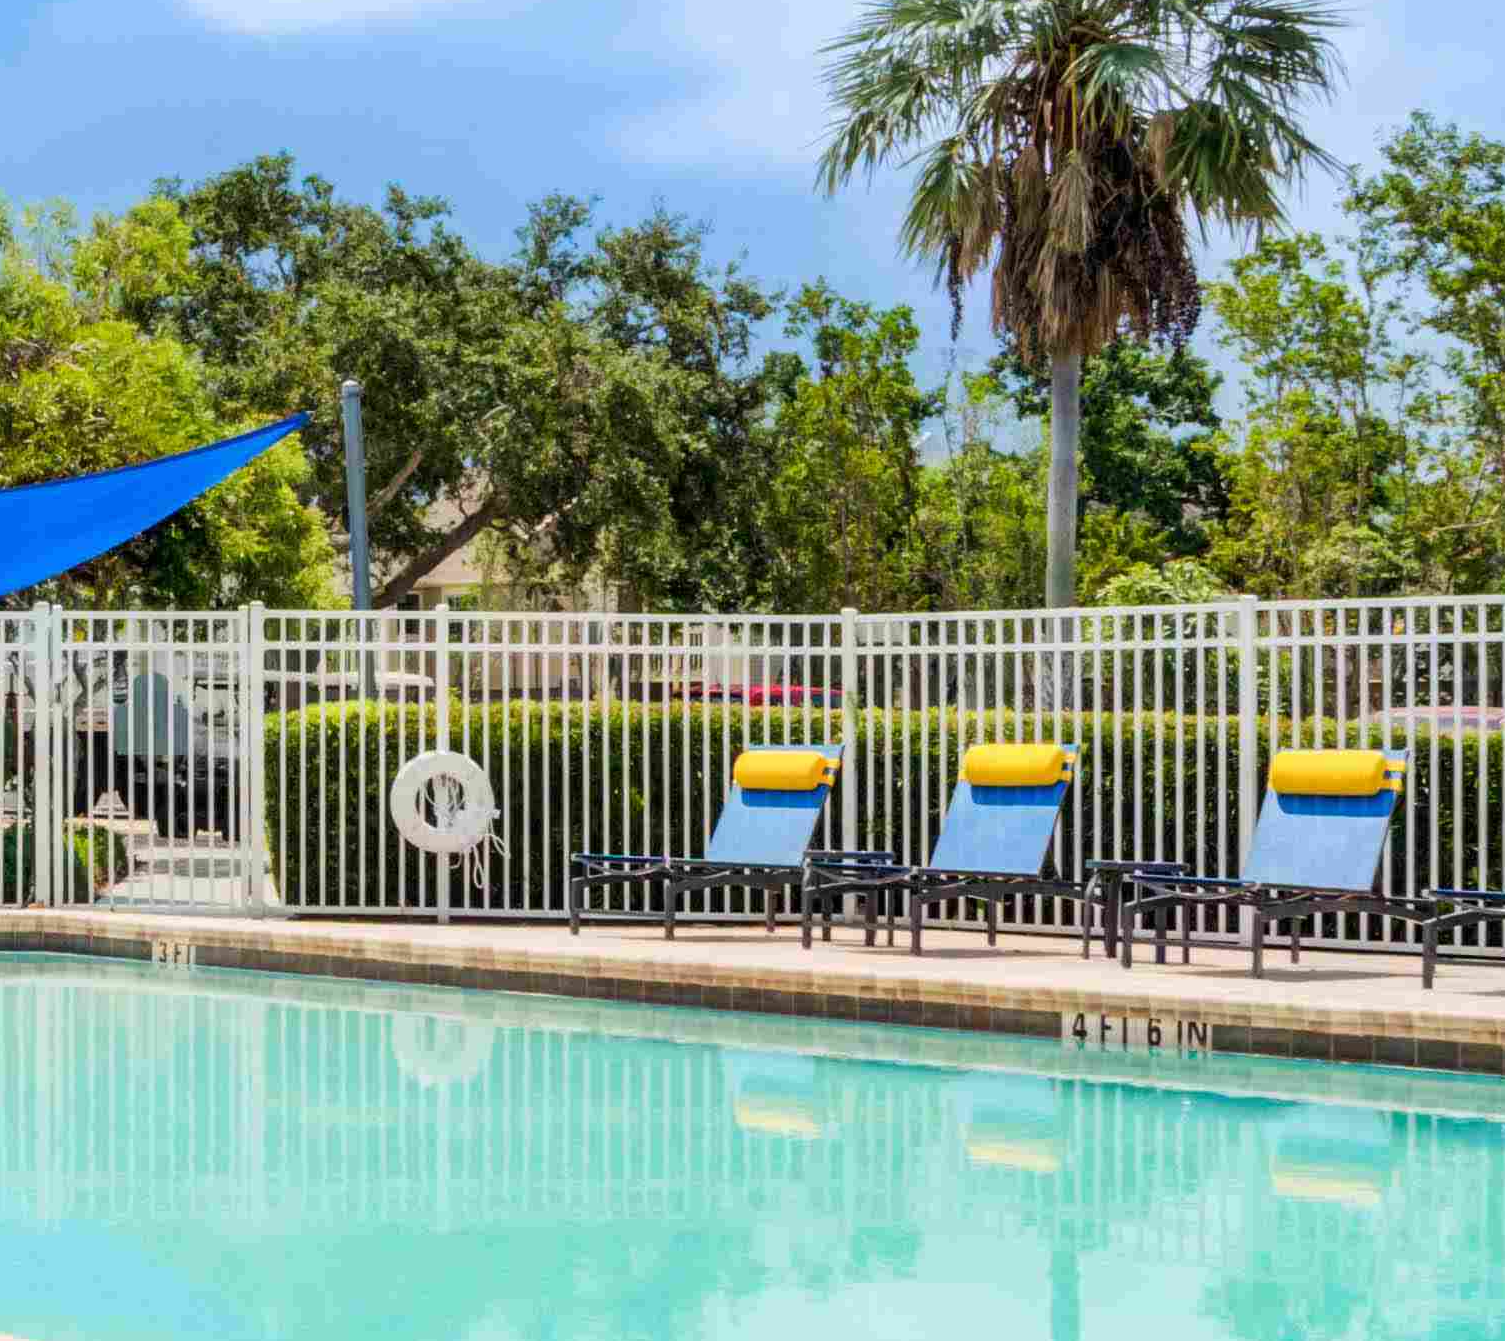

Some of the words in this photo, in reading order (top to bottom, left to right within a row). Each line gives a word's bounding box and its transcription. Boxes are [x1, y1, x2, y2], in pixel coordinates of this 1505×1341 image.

[159, 941, 167, 963] 3
[1072, 1012, 1088, 1039] 4
[1148, 1017, 1162, 1046] 6
[1177, 1020, 1208, 1047] IN
